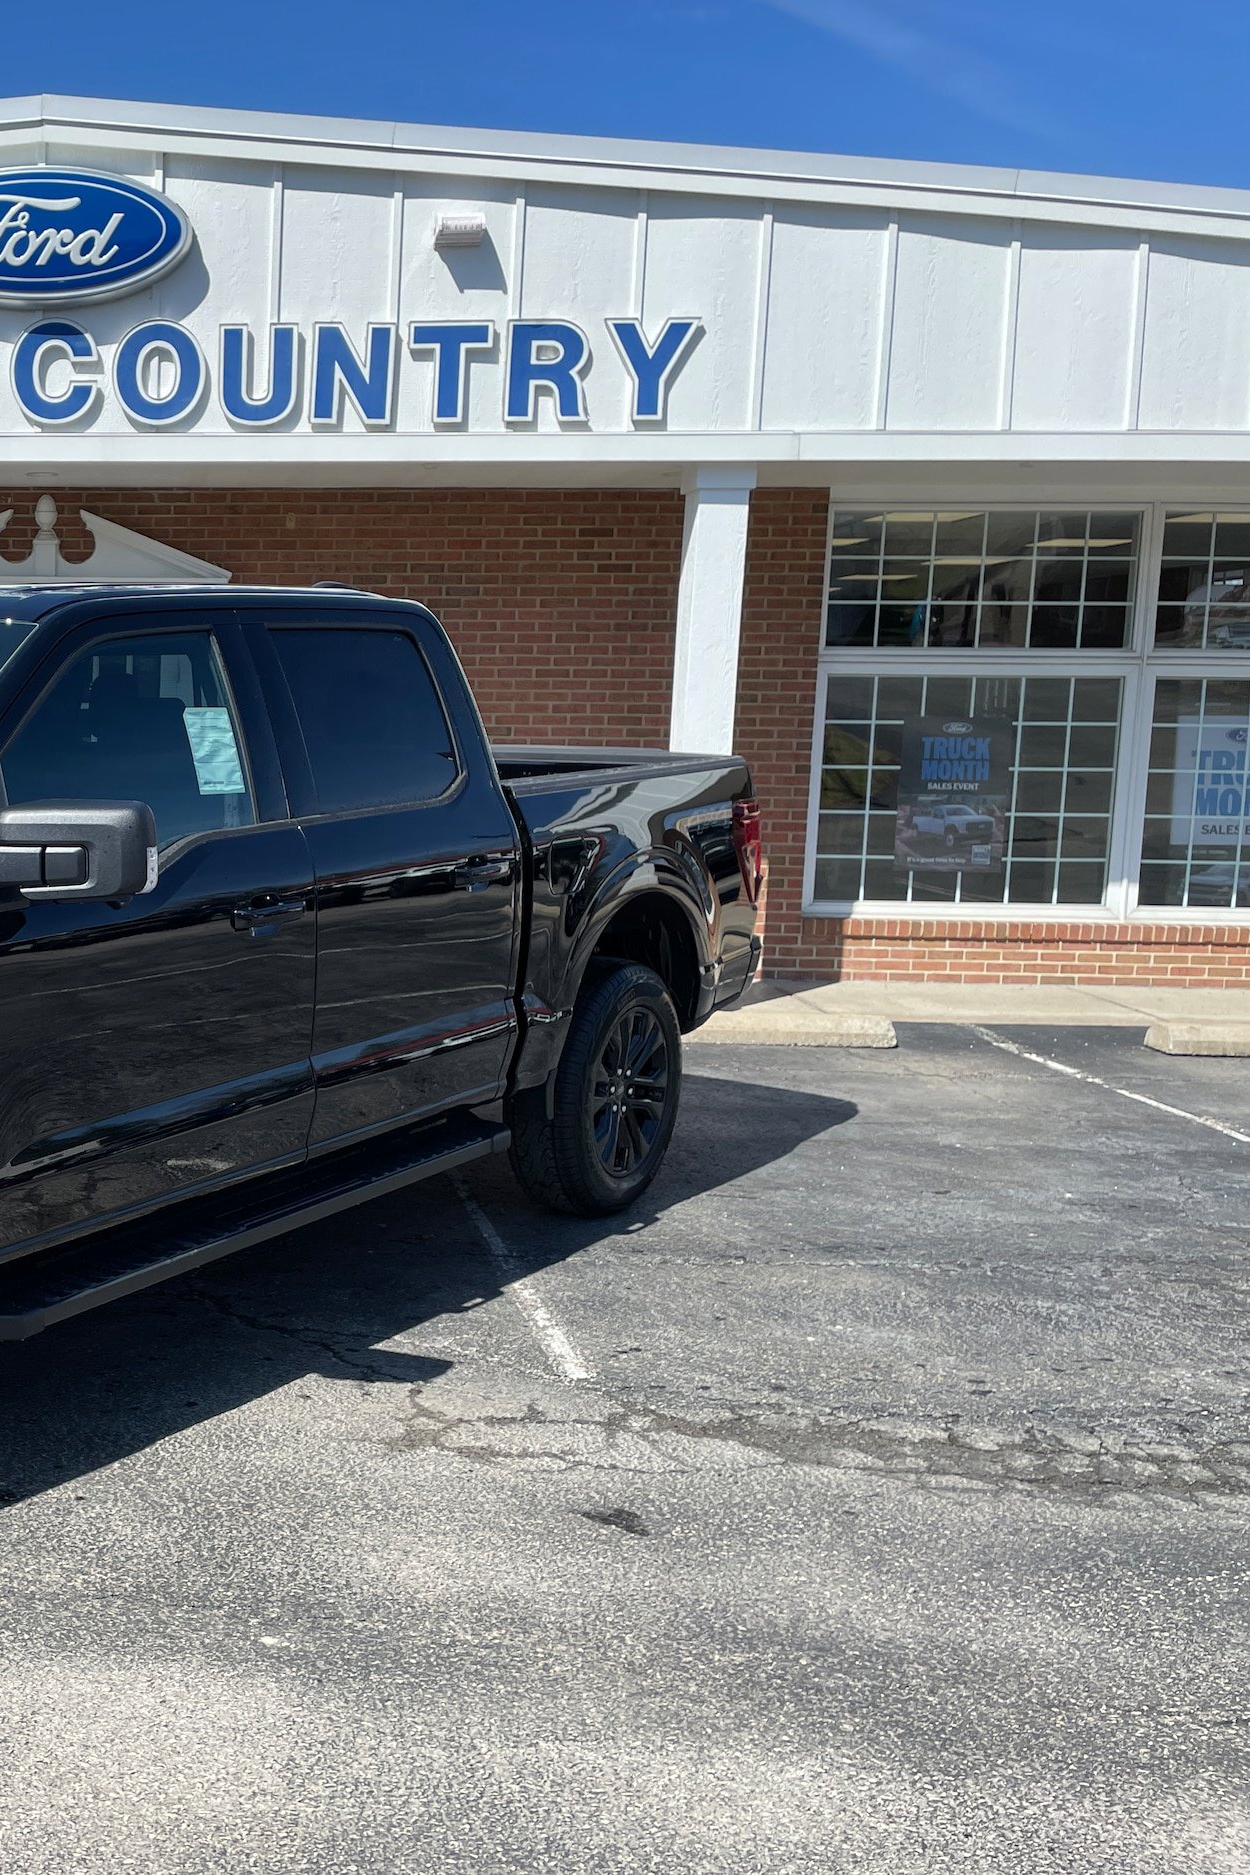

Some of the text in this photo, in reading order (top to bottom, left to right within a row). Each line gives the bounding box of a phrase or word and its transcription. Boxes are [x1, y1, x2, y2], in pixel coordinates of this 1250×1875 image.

[9, 317, 703, 426] COUNTRY
[921, 736, 991, 760] TRUCK
[921, 760, 990, 781] MONTH
[928, 782, 980, 791] SALES EVENT
